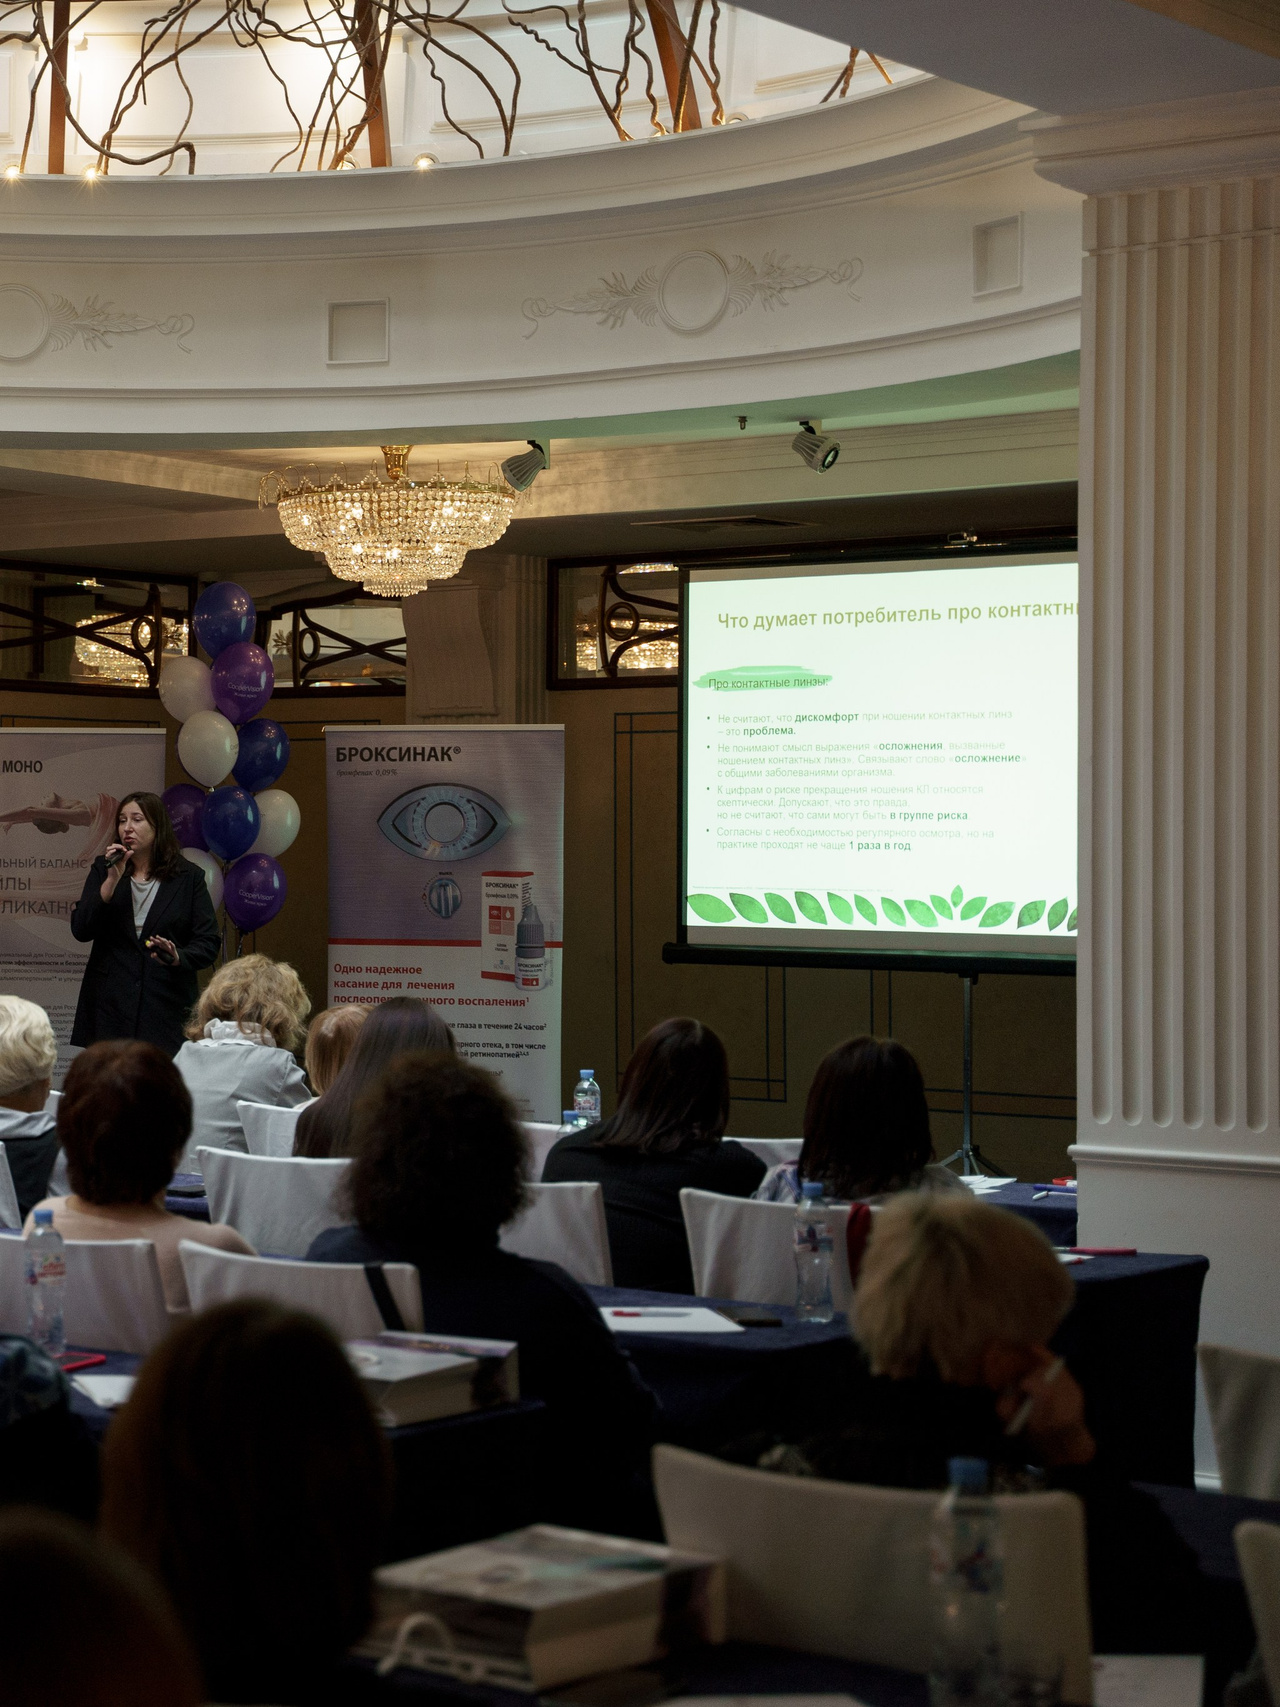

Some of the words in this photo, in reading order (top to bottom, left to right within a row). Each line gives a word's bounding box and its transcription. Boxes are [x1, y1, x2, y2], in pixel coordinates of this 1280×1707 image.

[718, 613, 749, 629] Что
[754, 613, 817, 631] думает
[823, 607, 941, 627] потребитель
[948, 606, 981, 623] про
[708, 679, 728, 690] Про
[731, 677, 790, 688] контактные
[793, 677, 828, 687] линзы:
[718, 714, 731, 723] Не
[733, 715, 774, 724] считают,
[777, 714, 792, 722] что
[795, 712, 859, 723] дискомфорт
[863, 713, 879, 721] при
[928, 711, 985, 720] контактных
[726, 728, 740, 736] это
[744, 726, 796, 737] проблема.
[718, 744, 730, 752] Не
[732, 744, 780, 752] понимают
[783, 744, 812, 752] смысл
[816, 743, 870, 752] выражения
[949, 742, 1005, 750] вызванные
[717, 757, 765, 765] ношением
[768, 756, 821, 764] контактных
[858, 754, 912, 763] Связывают
[2, 760, 43, 773] МОНО
[337, 769, 373, 777] бромфенак
[725, 768, 762, 778] общими
[765, 768, 838, 777] заболеваниями
[717, 786, 723, 794] К
[725, 786, 763, 796] цифрам
[775, 786, 800, 796] риске
[804, 786, 867, 796] прекращения
[871, 786, 913, 794] ношения
[916, 784, 930, 794] КЛ
[932, 785, 985, 794] относятся
[835, 799, 851, 807] что
[854, 799, 869, 807] это
[833, 811, 859, 822] могут
[863, 811, 886, 820] быть
[899, 812, 934, 822] группе
[717, 827, 762, 837] Согласны
[773, 828, 853, 837] необходимостью
[857, 829, 916, 839] регулярного
[717, 841, 757, 850] практике
[761, 841, 803, 850] проходят
[807, 842, 818, 850] не
[821, 842, 845, 850] чаще
[849, 841, 854, 850] 1
[858, 842, 881, 852] раза
[40, 859, 88, 869] БАЛАНС
[334, 963, 362, 974] Одно
[365, 965, 422, 975] надежное
[334, 980, 379, 989] касание
[381, 980, 402, 991] для
[407, 982, 455, 990] лечения
[334, 995, 455, 1005] послеопенного
